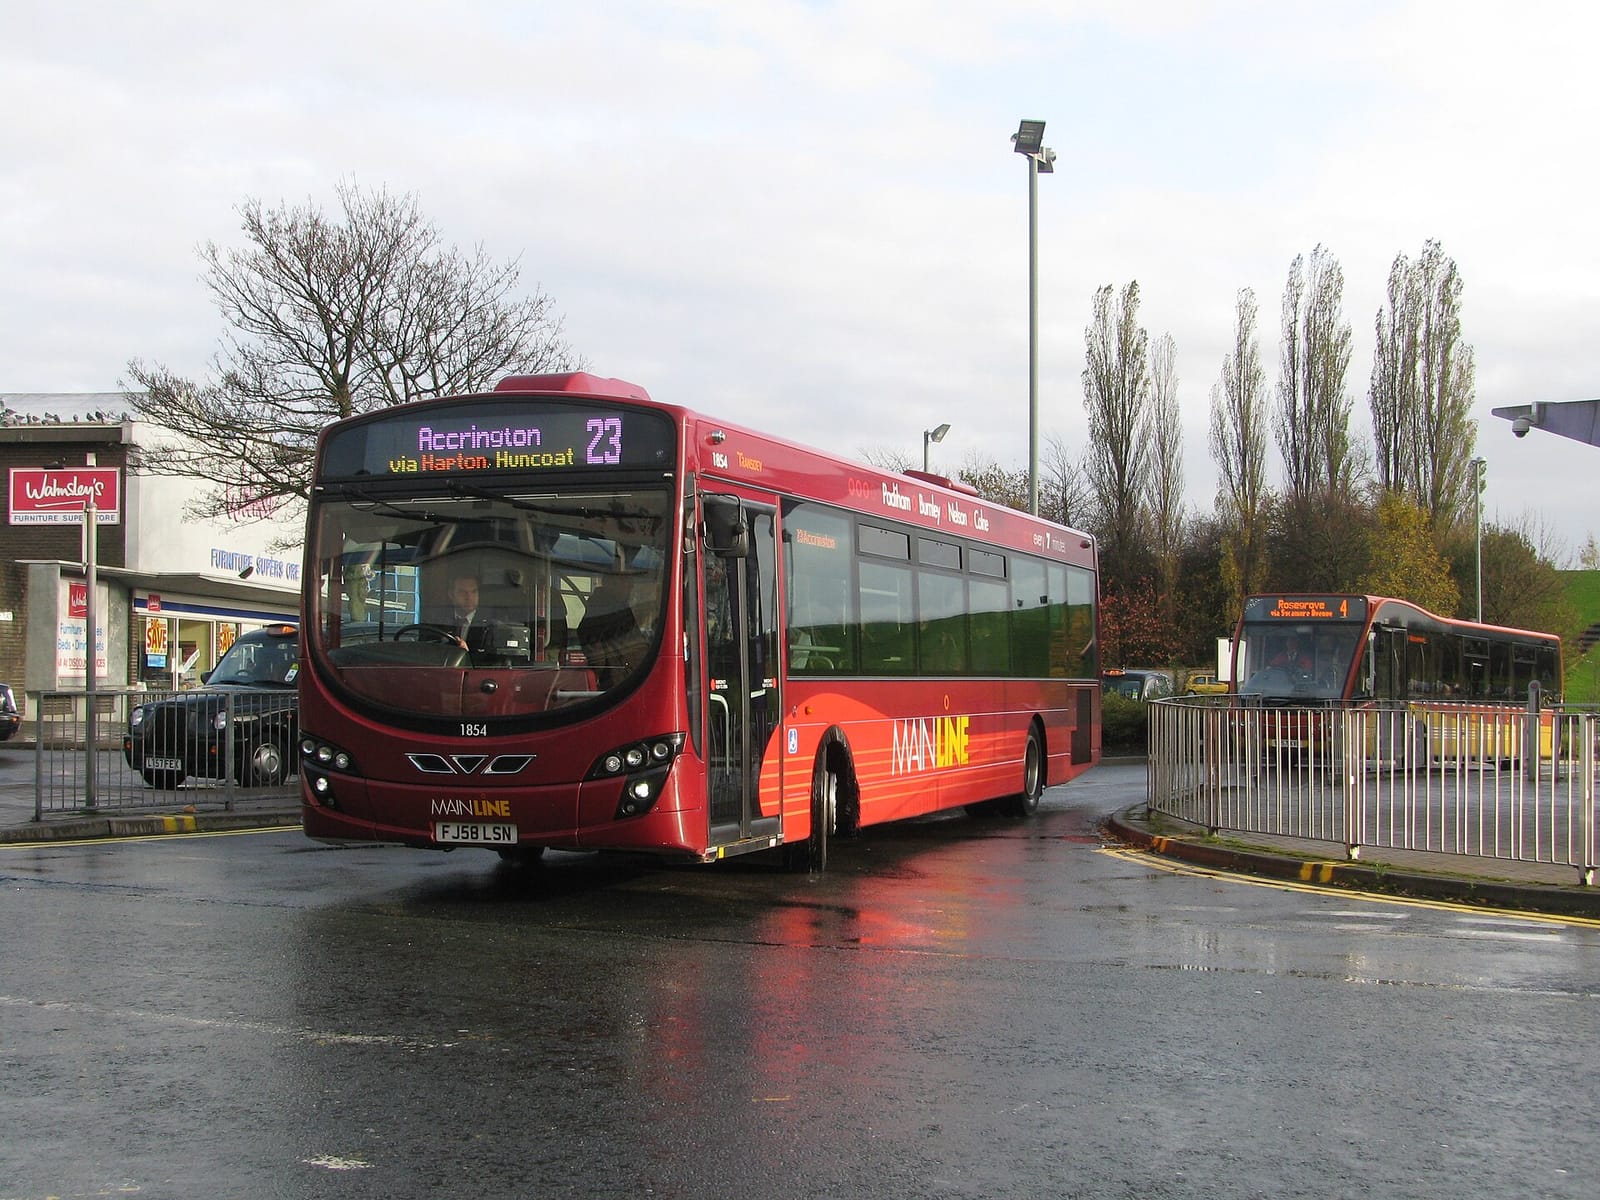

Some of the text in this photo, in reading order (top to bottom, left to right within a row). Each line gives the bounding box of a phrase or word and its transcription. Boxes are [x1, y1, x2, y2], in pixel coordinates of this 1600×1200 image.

[418, 425, 541, 450] Accrington
[586, 418, 622, 465] 23
[389, 456, 418, 473] via
[496, 448, 574, 468] Huncoat
[712, 451, 728, 469] 1854
[26, 473, 104, 504] Walmsley's
[14, 514, 116, 522] FURNITURE SUPETORE
[919, 493, 941, 525] Burnley
[947, 501, 968, 526] Nelson
[973, 509, 989, 532] Colne
[1045, 532, 1050, 549] 7
[211, 548, 253, 573] FURNITURE
[1278, 599, 1326, 610] Rosegrove
[1340, 599, 1348, 618] 4
[147, 628, 166, 648] SAVE
[460, 723, 487, 736] 1854
[441, 825, 511, 841] FJ58 LSN
